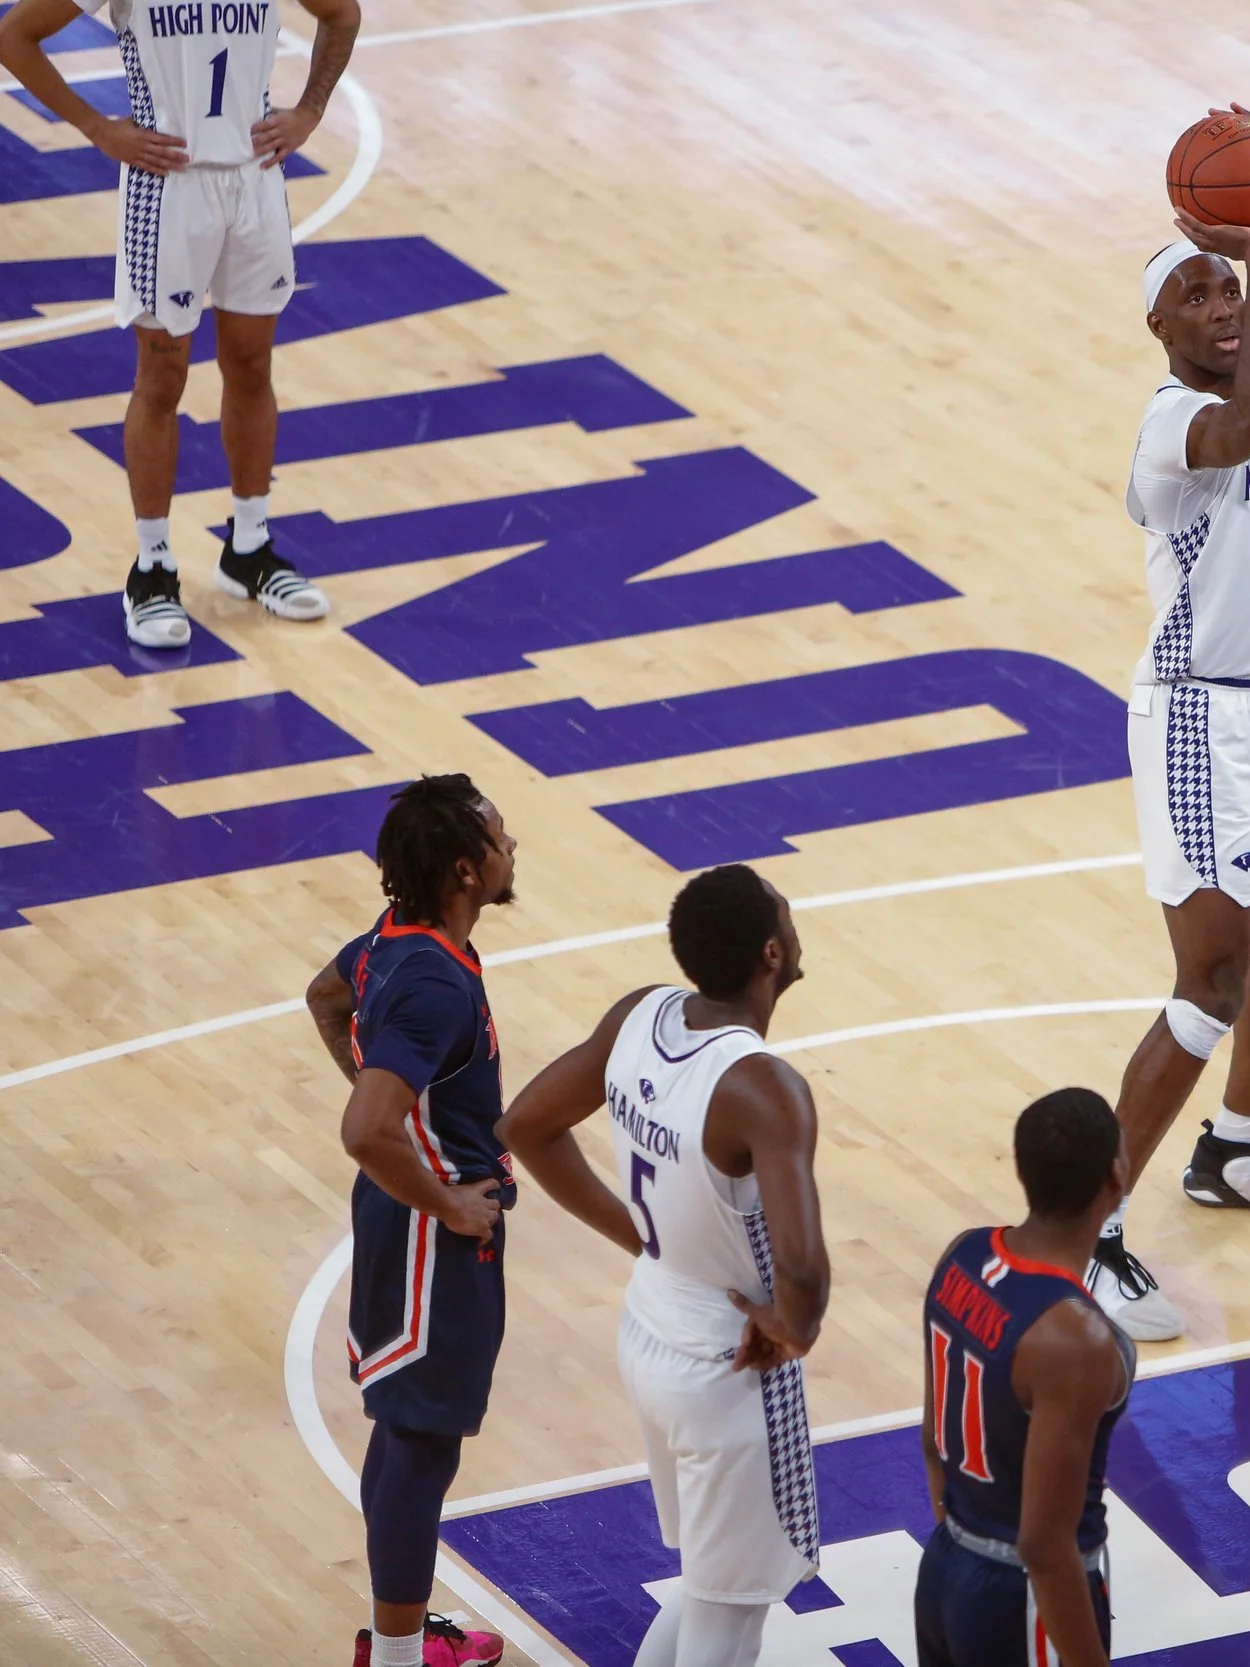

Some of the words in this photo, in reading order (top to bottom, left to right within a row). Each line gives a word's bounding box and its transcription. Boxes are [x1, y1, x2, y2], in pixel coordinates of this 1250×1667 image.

[149, 3, 203, 37] HIGH
[211, 3, 269, 34] POINT
[205, 46, 228, 117] 1
[607, 1080, 681, 1165] HAMILTON
[631, 1150, 661, 1261] 5
[935, 1263, 1012, 1352] SIMPKINS
[930, 1320, 995, 1483] 11
